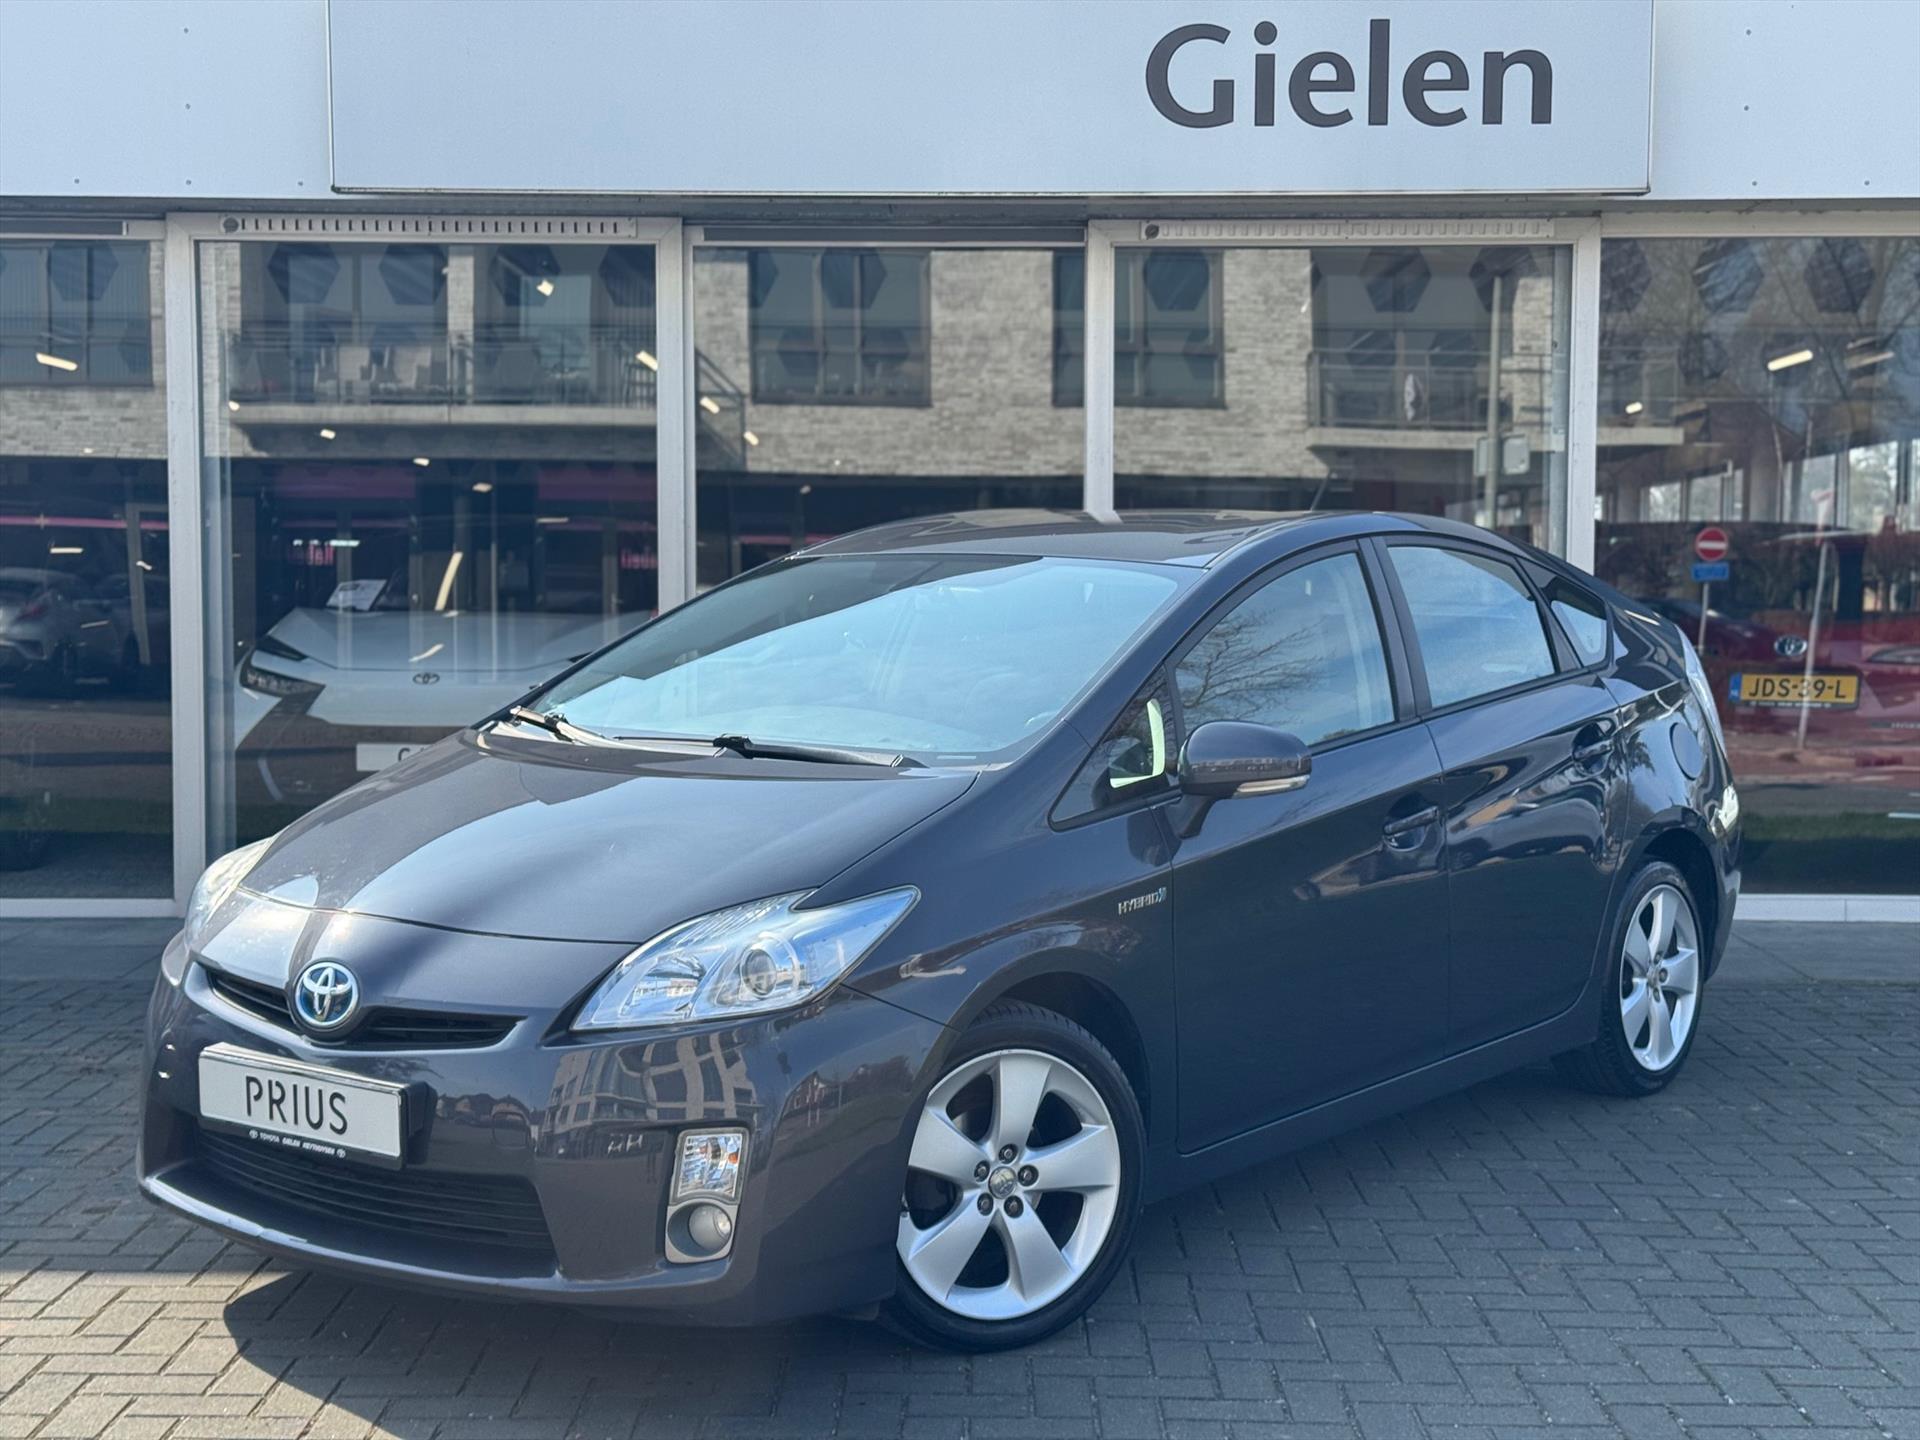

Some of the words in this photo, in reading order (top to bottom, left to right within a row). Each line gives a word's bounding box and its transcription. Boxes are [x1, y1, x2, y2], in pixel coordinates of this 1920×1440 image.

[1145, 18, 1553, 129] Gielen
[1748, 678, 1847, 699] JDS-39-L
[1118, 892, 1159, 915] HYBRID
[245, 1075, 348, 1135] PRIUS
[260, 1132, 280, 1143] TOYOTA
